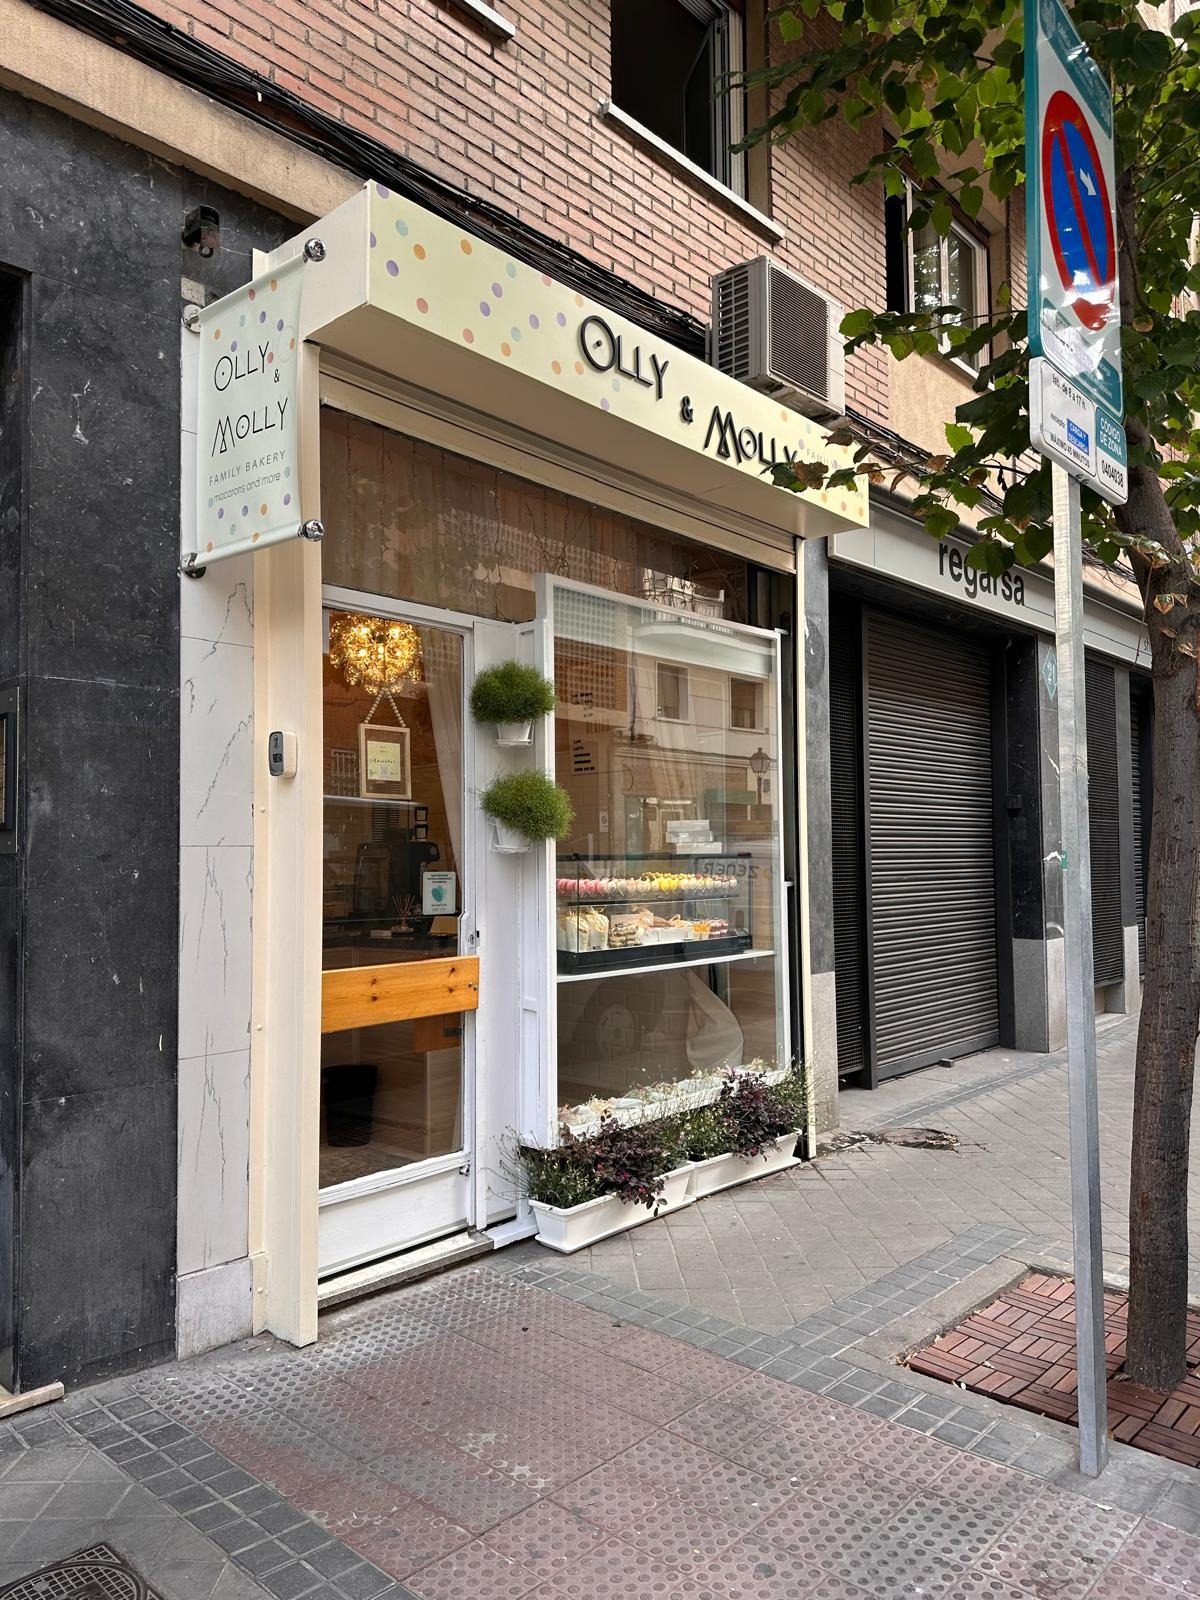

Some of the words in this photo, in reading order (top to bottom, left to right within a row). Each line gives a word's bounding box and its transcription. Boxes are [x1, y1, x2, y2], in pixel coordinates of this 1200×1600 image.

[214, 341, 270, 391] OLLY
[273, 368, 281, 383] &
[579, 315, 670, 400] OLLY
[681, 395, 694, 423] &
[211, 397, 289, 457] MOLLY
[1099, 431, 1108, 447] DE
[1107, 437, 1123, 459] ZONA
[1100, 417, 1121, 443] CÓDIGO
[209, 464, 242, 487] FAMILY
[245, 449, 286, 472] BAKERY
[213, 484, 246, 502] macarons
[246, 476, 260, 491] and
[261, 472, 281, 487] more
